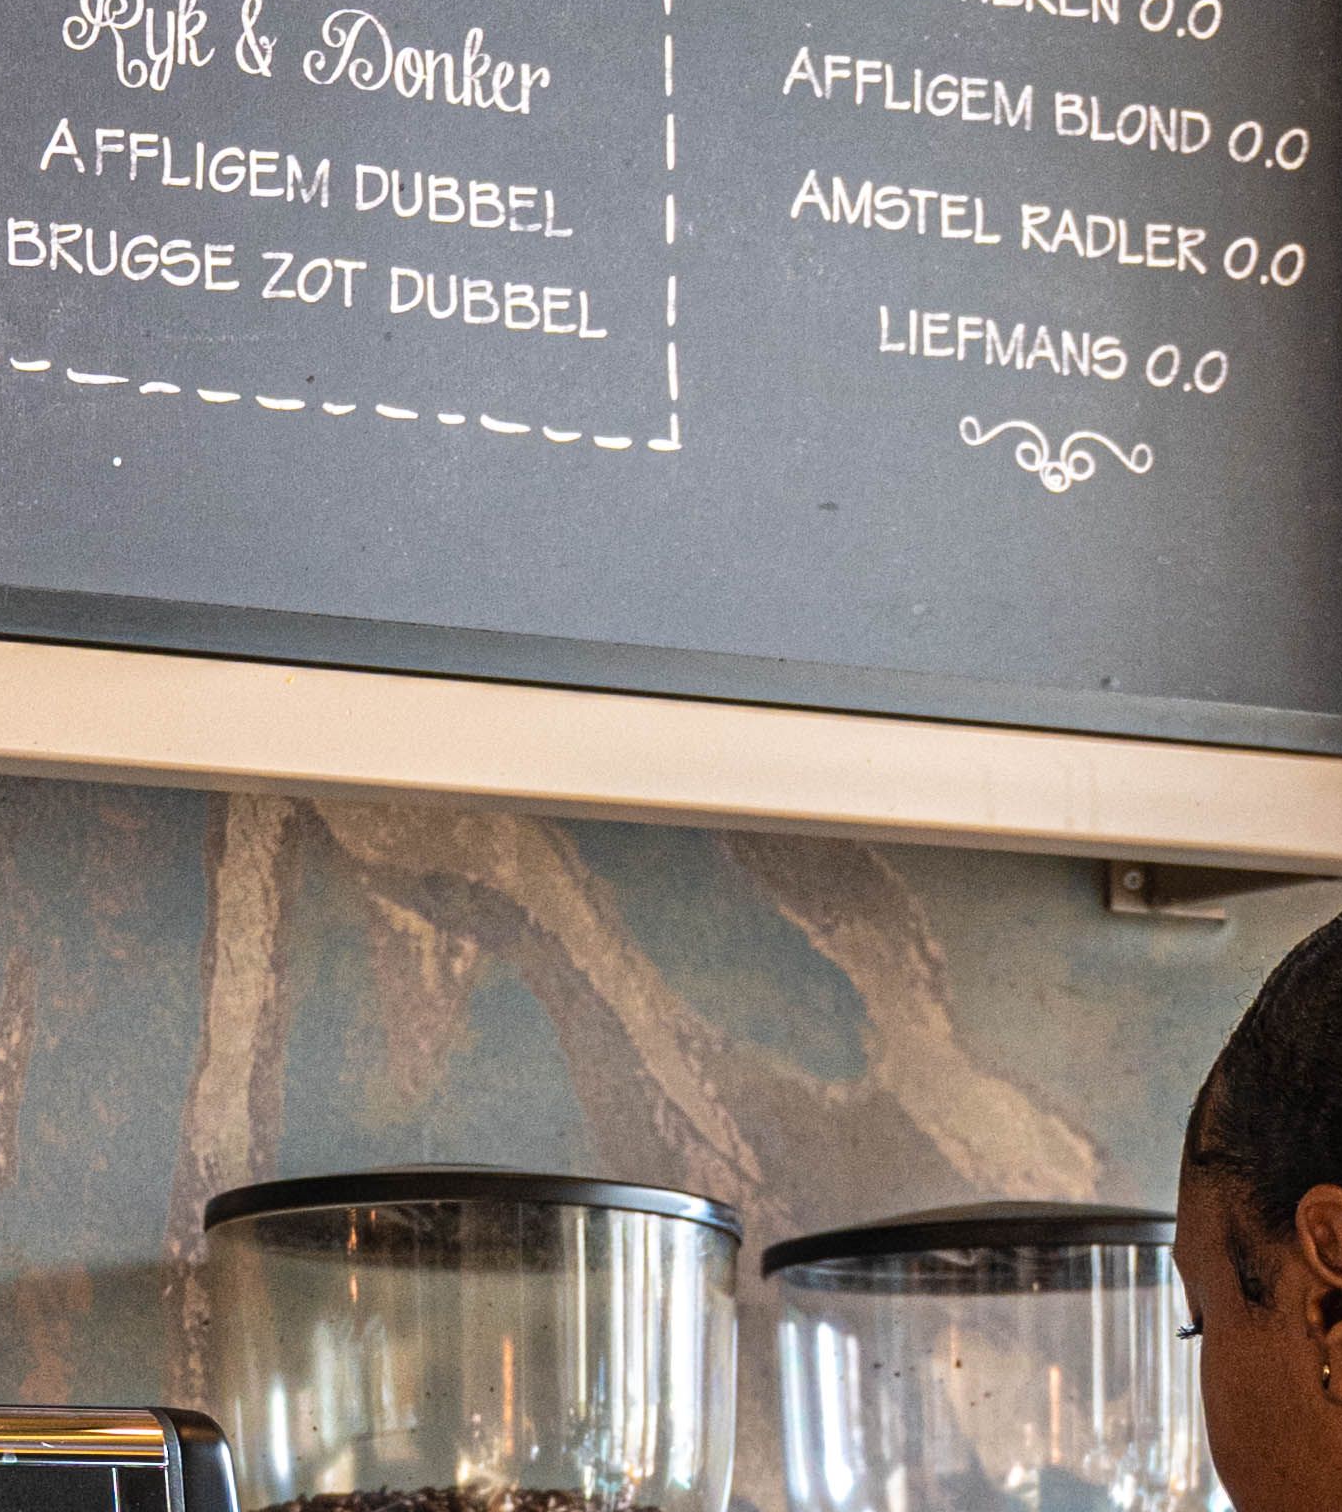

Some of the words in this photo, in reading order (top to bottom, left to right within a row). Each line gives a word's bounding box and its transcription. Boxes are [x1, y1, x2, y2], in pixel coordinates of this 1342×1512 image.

[302, 8, 551, 117] Donker
[781, 45, 1034, 132] AFFLIGEM
[1054, 90, 1212, 157] BLOND
[1227, 118, 1311, 171] 0.0
[39, 117, 332, 209] AFFLIGEM
[354, 163, 574, 238] DUBBEL
[790, 168, 1002, 247] AMSTEL
[1020, 202, 1208, 276] RADLER
[1222, 236, 1307, 288] 0.0
[6, 217, 240, 291] BRUGSE
[260, 251, 368, 309] ZOT
[389, 266, 608, 339] DUBBEL
[879, 305, 1128, 381] LIEFMANS
[1144, 344, 1229, 395] 0.0
